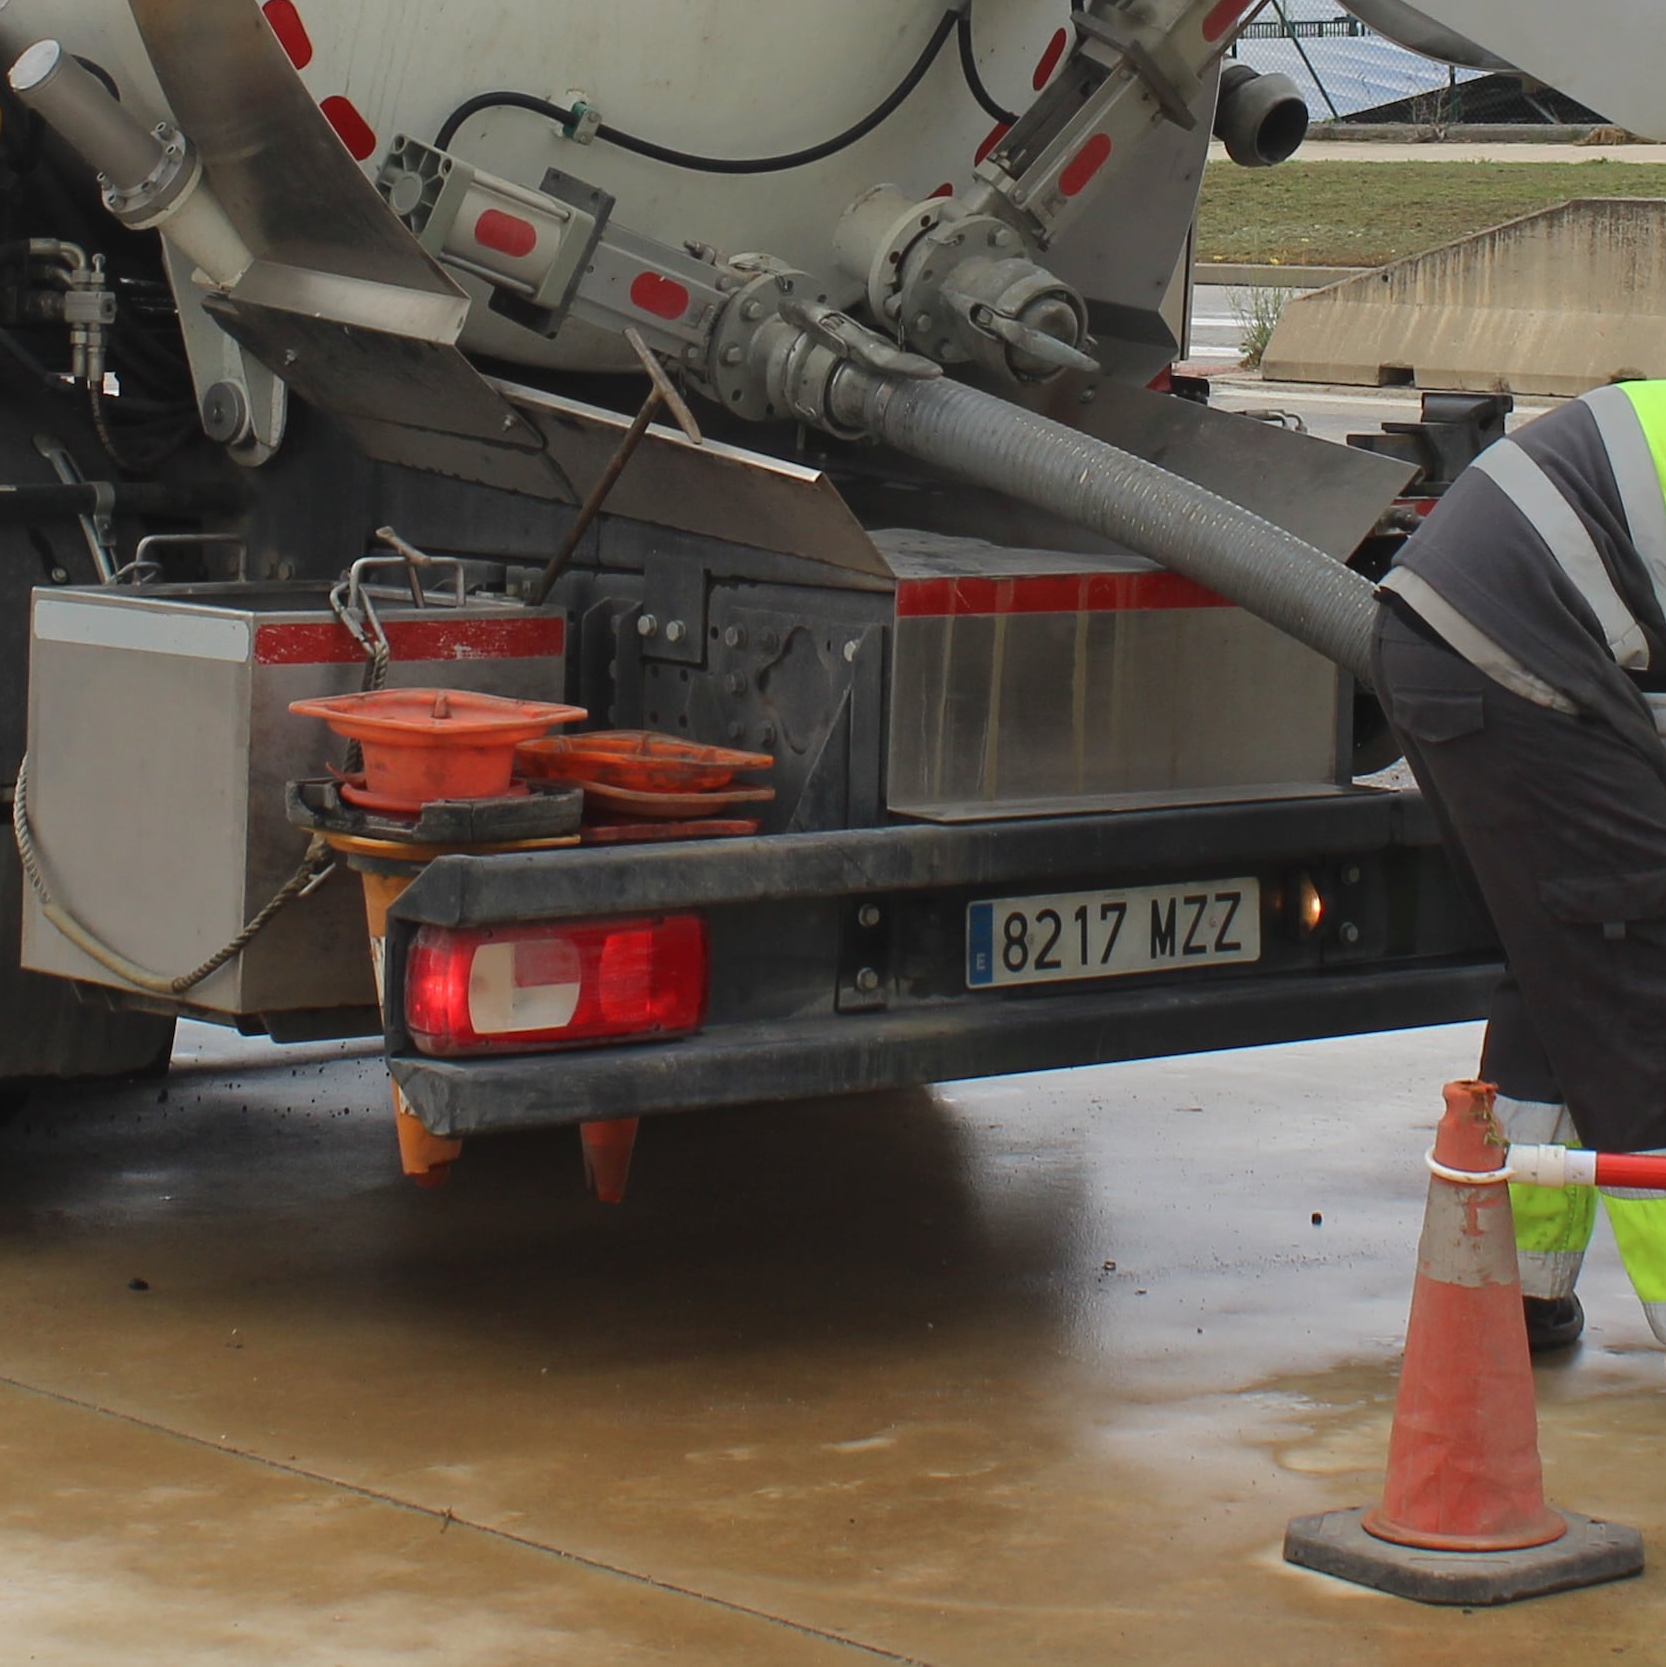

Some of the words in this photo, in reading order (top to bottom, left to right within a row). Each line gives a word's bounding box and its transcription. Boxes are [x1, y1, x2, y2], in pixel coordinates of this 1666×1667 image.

[976, 952, 986, 971] E
[1002, 901, 1128, 973] 8217
[1150, 891, 1242, 960] MZZ
